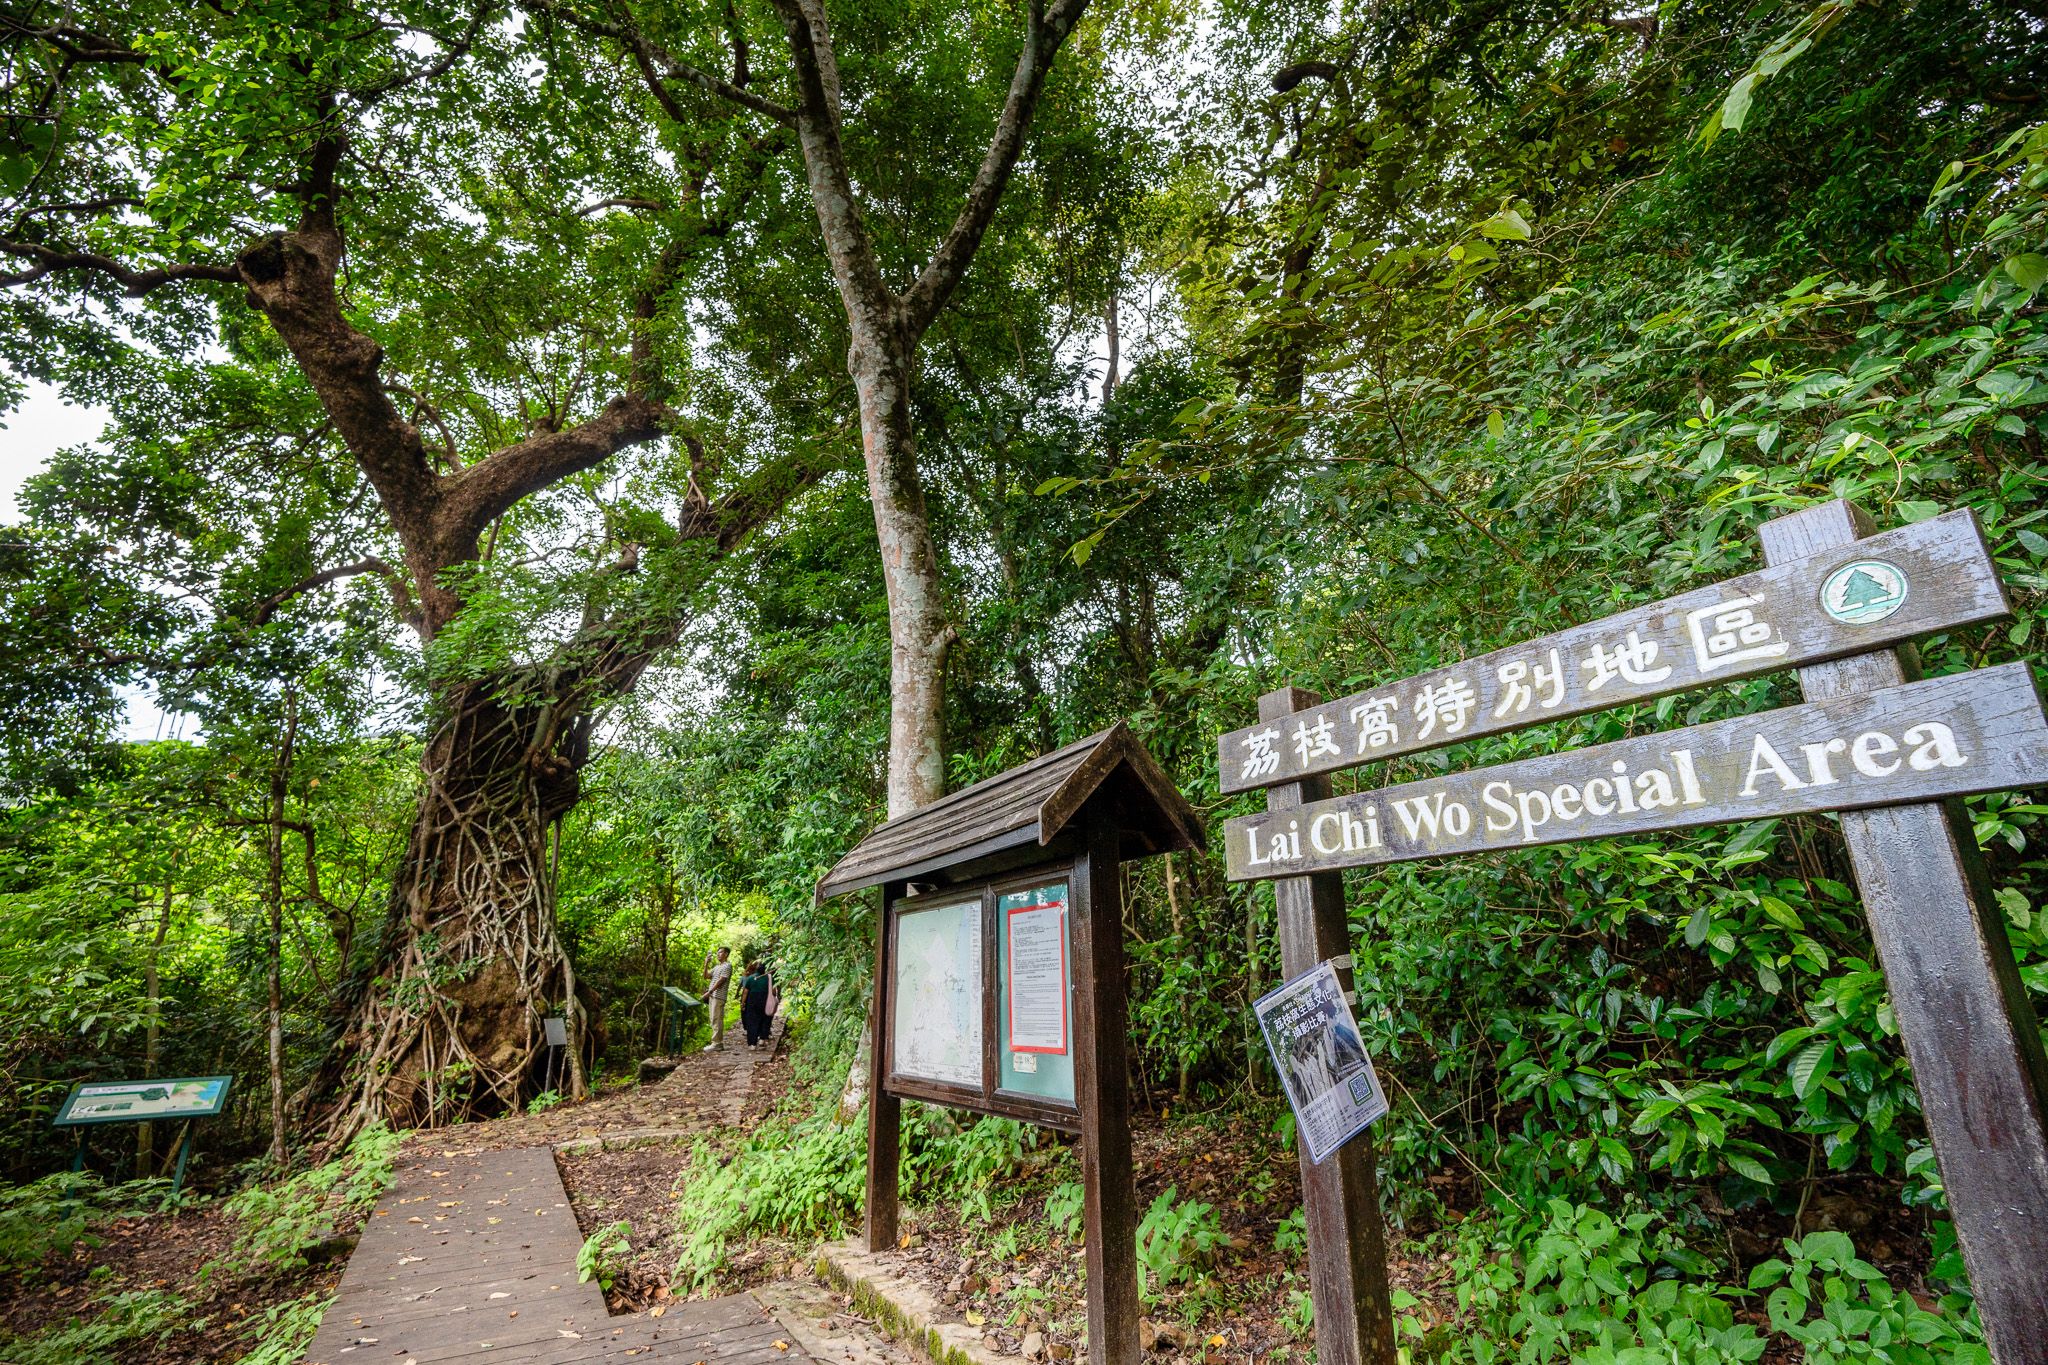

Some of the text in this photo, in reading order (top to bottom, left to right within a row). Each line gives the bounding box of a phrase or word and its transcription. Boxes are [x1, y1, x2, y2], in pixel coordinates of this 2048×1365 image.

[1240, 592, 1790, 780] 荔枝窩特別地區
[1246, 721, 1969, 866] Lai Chi Wo Special Area
